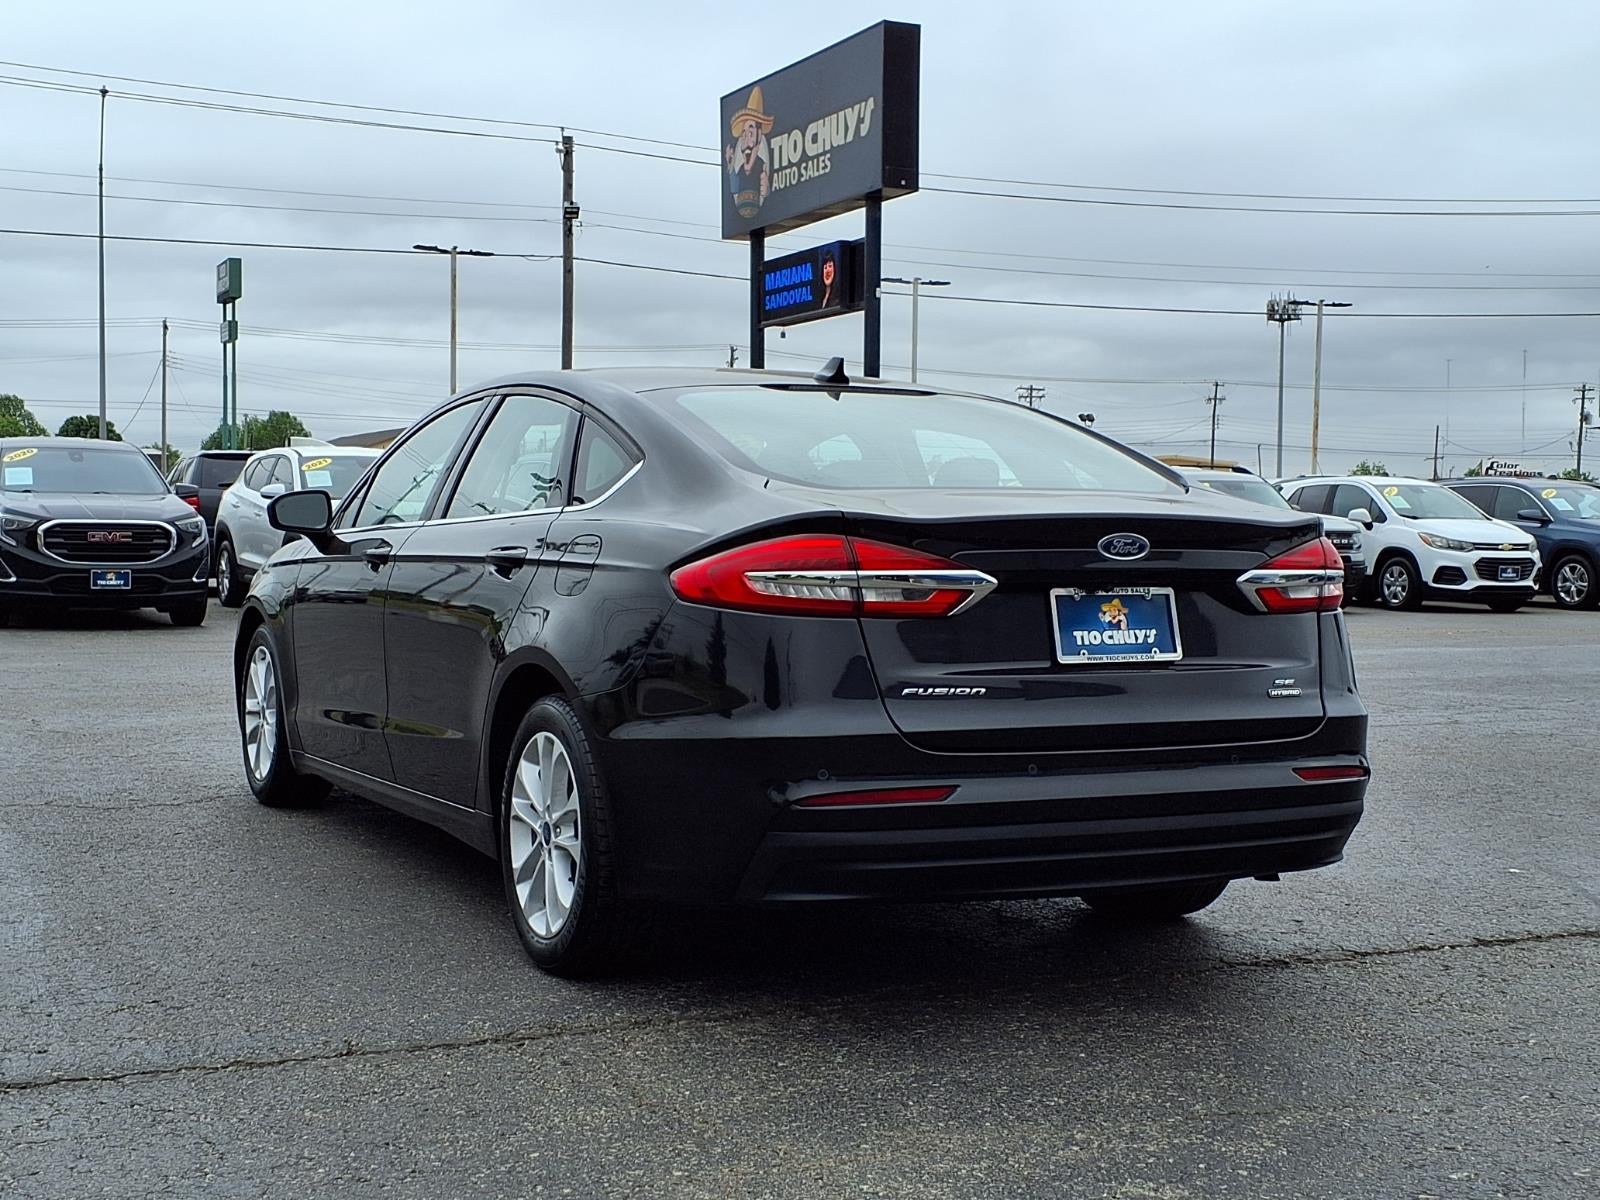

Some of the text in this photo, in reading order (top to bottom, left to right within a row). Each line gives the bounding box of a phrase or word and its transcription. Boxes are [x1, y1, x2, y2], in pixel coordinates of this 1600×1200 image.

[770, 96, 875, 169] TIO CHUY'S
[772, 153, 831, 192] AUTO SALES
[765, 262, 813, 291] MARIANA
[765, 285, 813, 310] SANDOVAL
[1485, 466, 1544, 478] Creations
[1490, 461, 1519, 470] Color
[88, 531, 132, 542] GMC
[1110, 538, 1140, 554] Ford
[1073, 628, 1157, 645] TIO CHUY'S
[902, 687, 987, 696] FUSION
